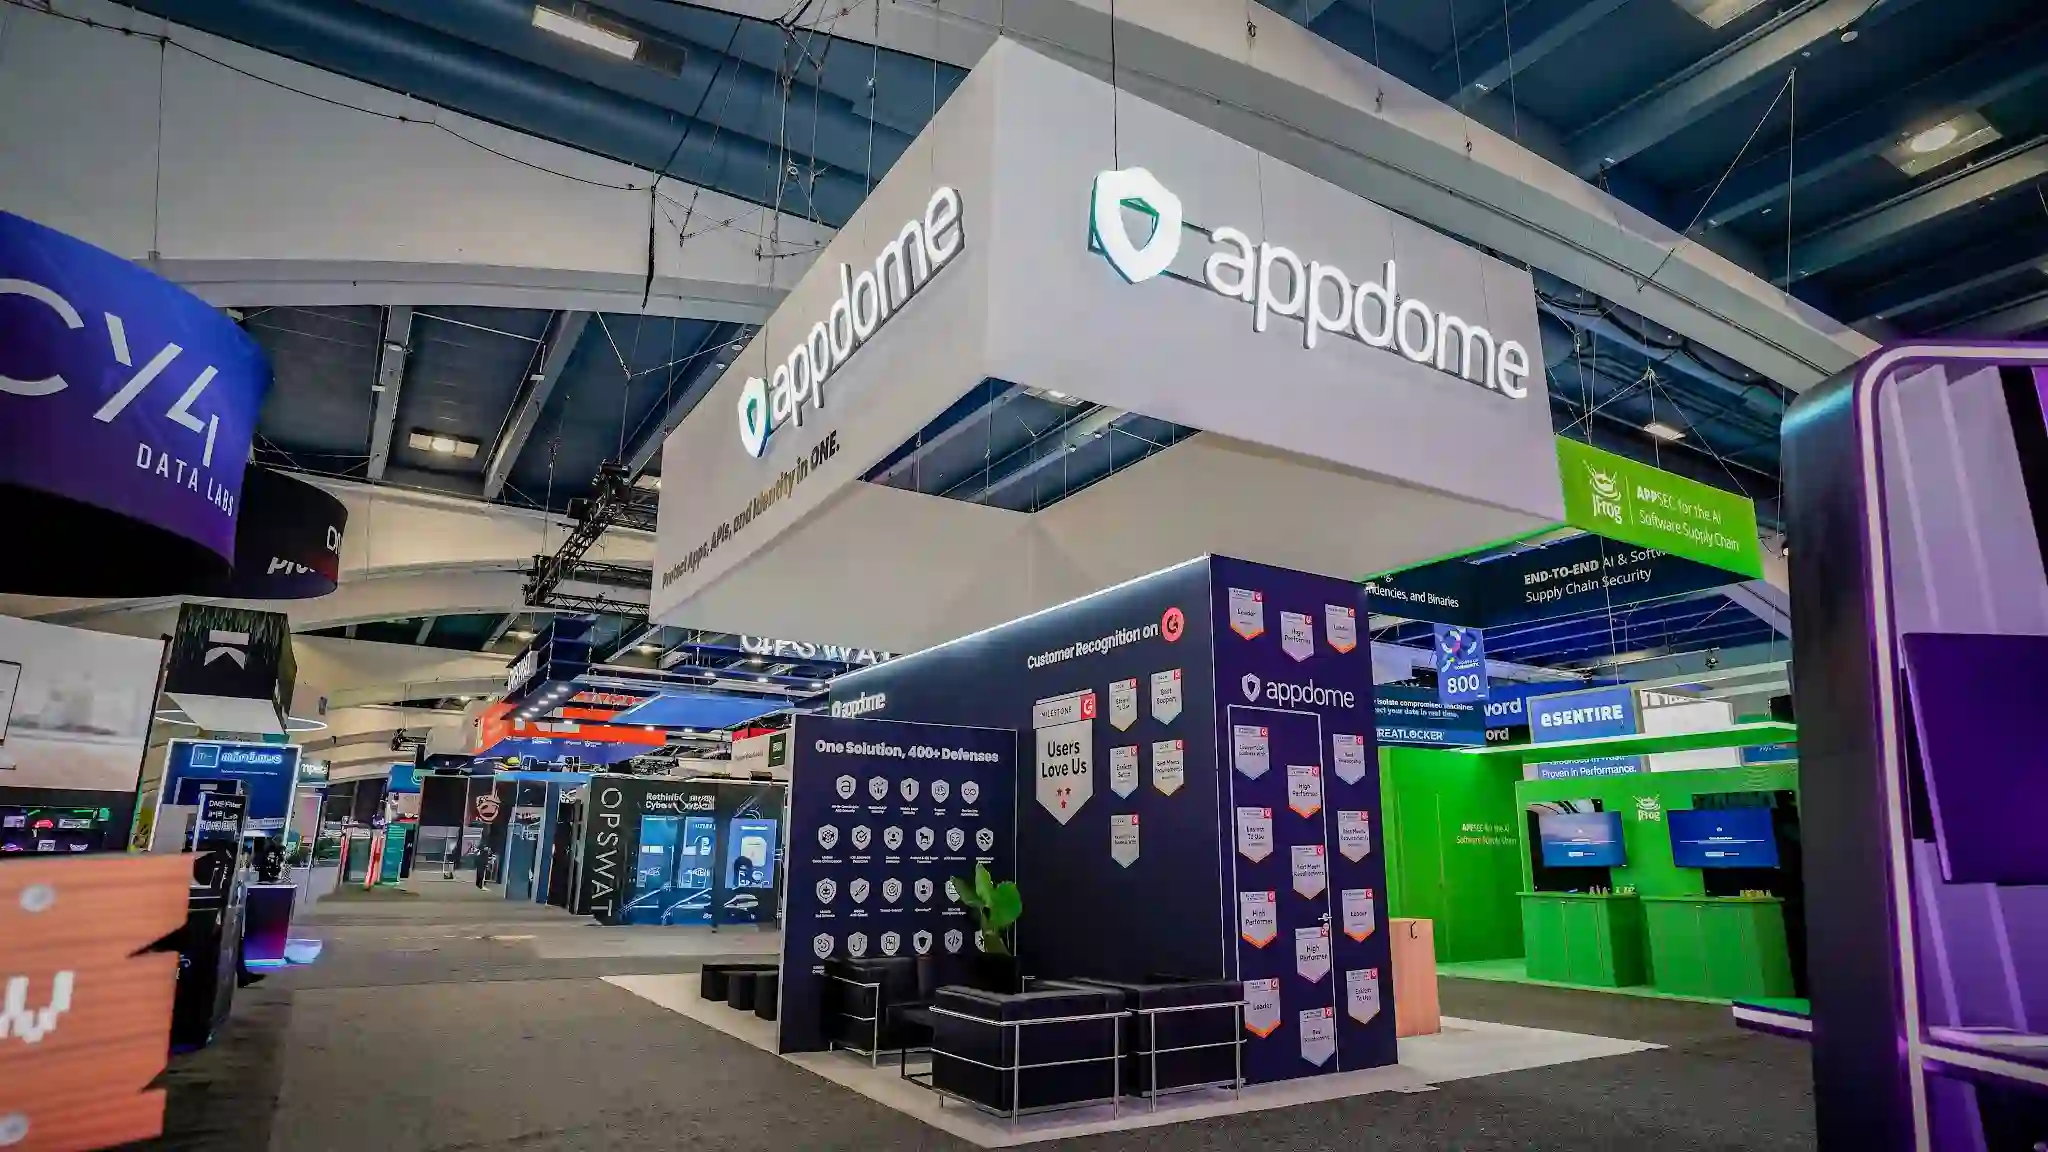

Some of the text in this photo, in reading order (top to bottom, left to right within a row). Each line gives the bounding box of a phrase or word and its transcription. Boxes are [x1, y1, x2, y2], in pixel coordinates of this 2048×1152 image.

[772, 186, 966, 427] appdome
[1203, 226, 1530, 400] appdome
[137, 442, 234, 517] DATA LABS
[733, 500, 752, 535] and
[797, 456, 809, 485] in
[811, 430, 840, 472] ONE.
[1636, 486, 1722, 524] APPSEC for the AI
[1639, 509, 1740, 551] Software Supply Chain
[1523, 560, 1600, 585] END-TO-END
[1603, 556, 1614, 569] AI
[1617, 553, 1628, 566] &
[1525, 568, 1652, 603] Supply Chain Security
[1410, 591, 1426, 603] and
[1427, 593, 1460, 608] Binaries
[1027, 645, 1075, 669] Customer
[1076, 628, 1141, 655] Recognition
[1142, 623, 1159, 638] on
[1266, 678, 1355, 709] appdome
[1447, 674, 1480, 694] 800
[815, 739, 999, 763] One Solution, 400+ Defenses
[1047, 740, 1080, 758] Users
[1041, 757, 1087, 779] Love Us
[1571, 767, 1579, 777] in
[1580, 764, 1637, 777] Performance.
[588, 786, 623, 917] OPSWAT
